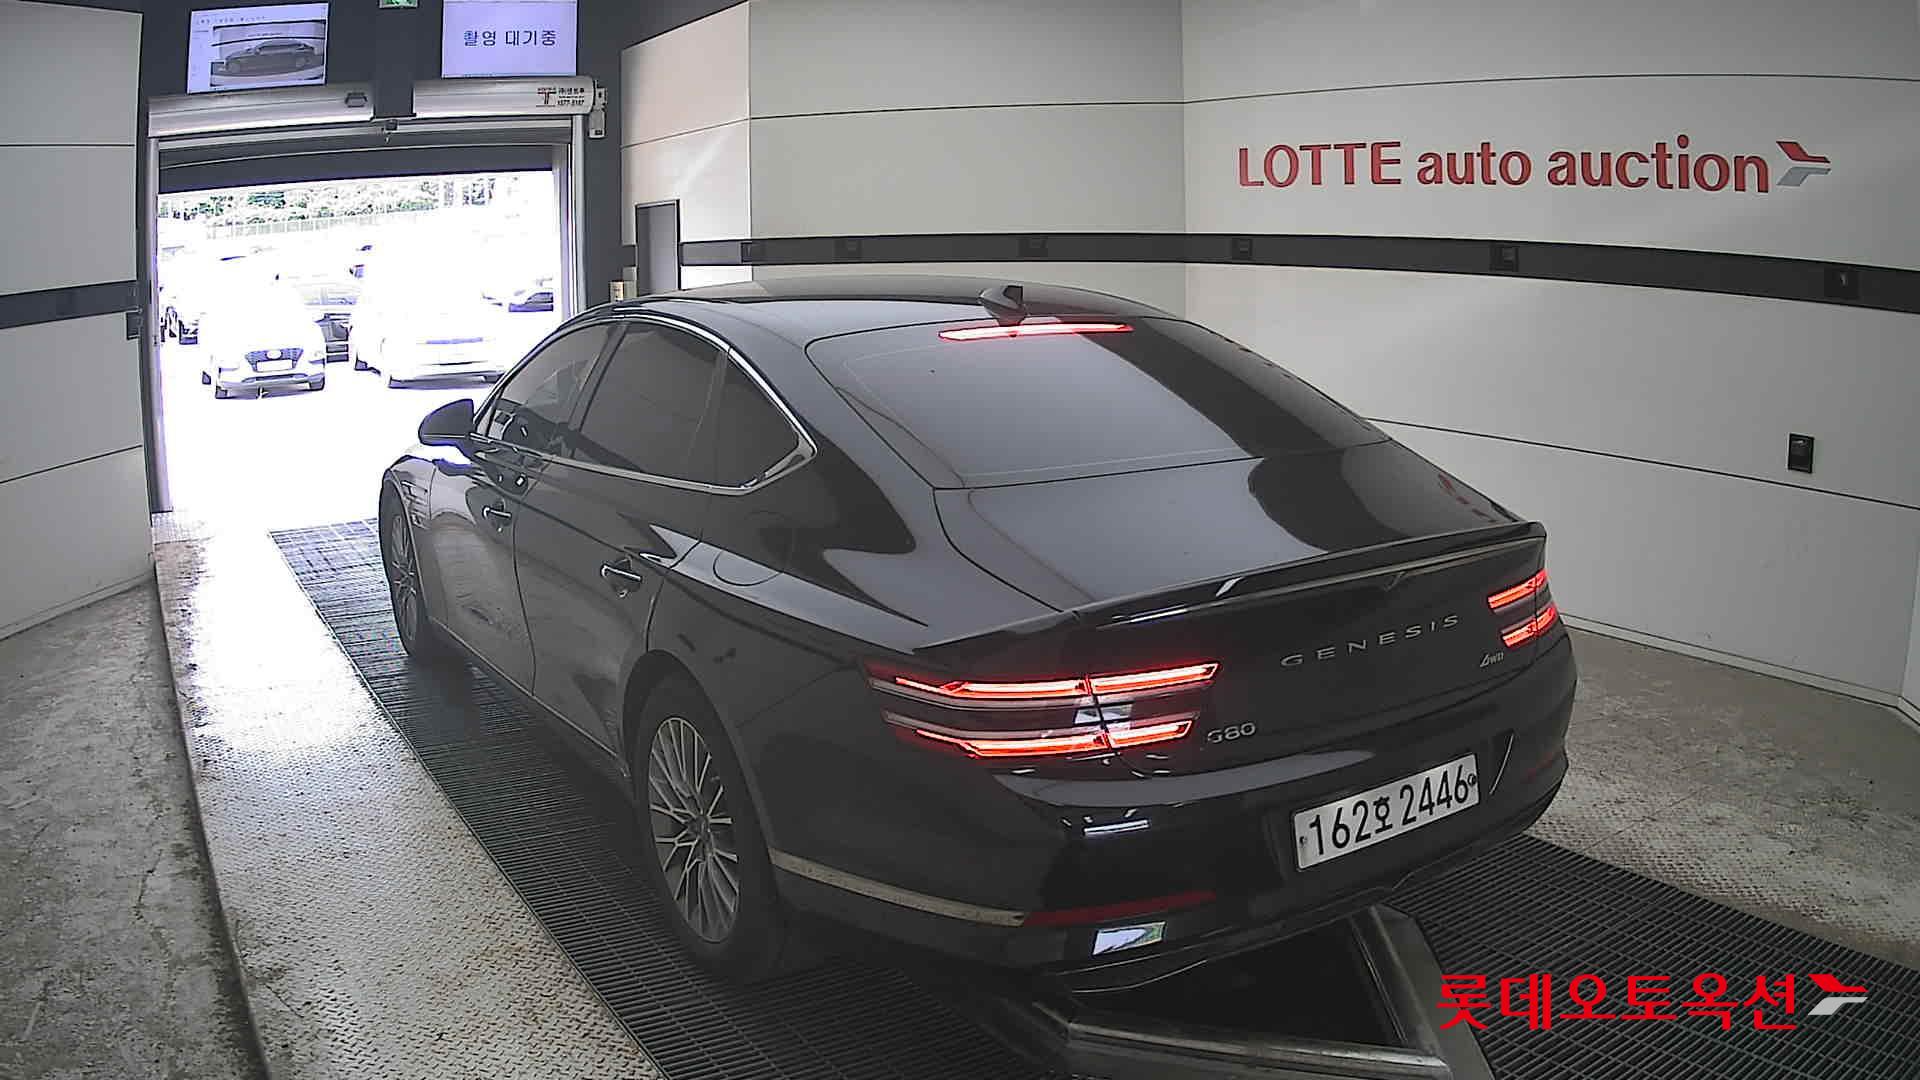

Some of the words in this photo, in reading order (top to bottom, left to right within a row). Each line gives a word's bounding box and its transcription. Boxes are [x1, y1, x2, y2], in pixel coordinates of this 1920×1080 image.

[505, 30, 557, 46] 대기중
[1239, 141, 1401, 187] LOTTE
[1417, 141, 1532, 187] auto
[1547, 134, 1769, 193] auction
[1280, 614, 1460, 668] GENESIS
[1206, 721, 1257, 745] G80
[1309, 795, 1393, 856] 162호
[1399, 763, 1469, 827] 2446
